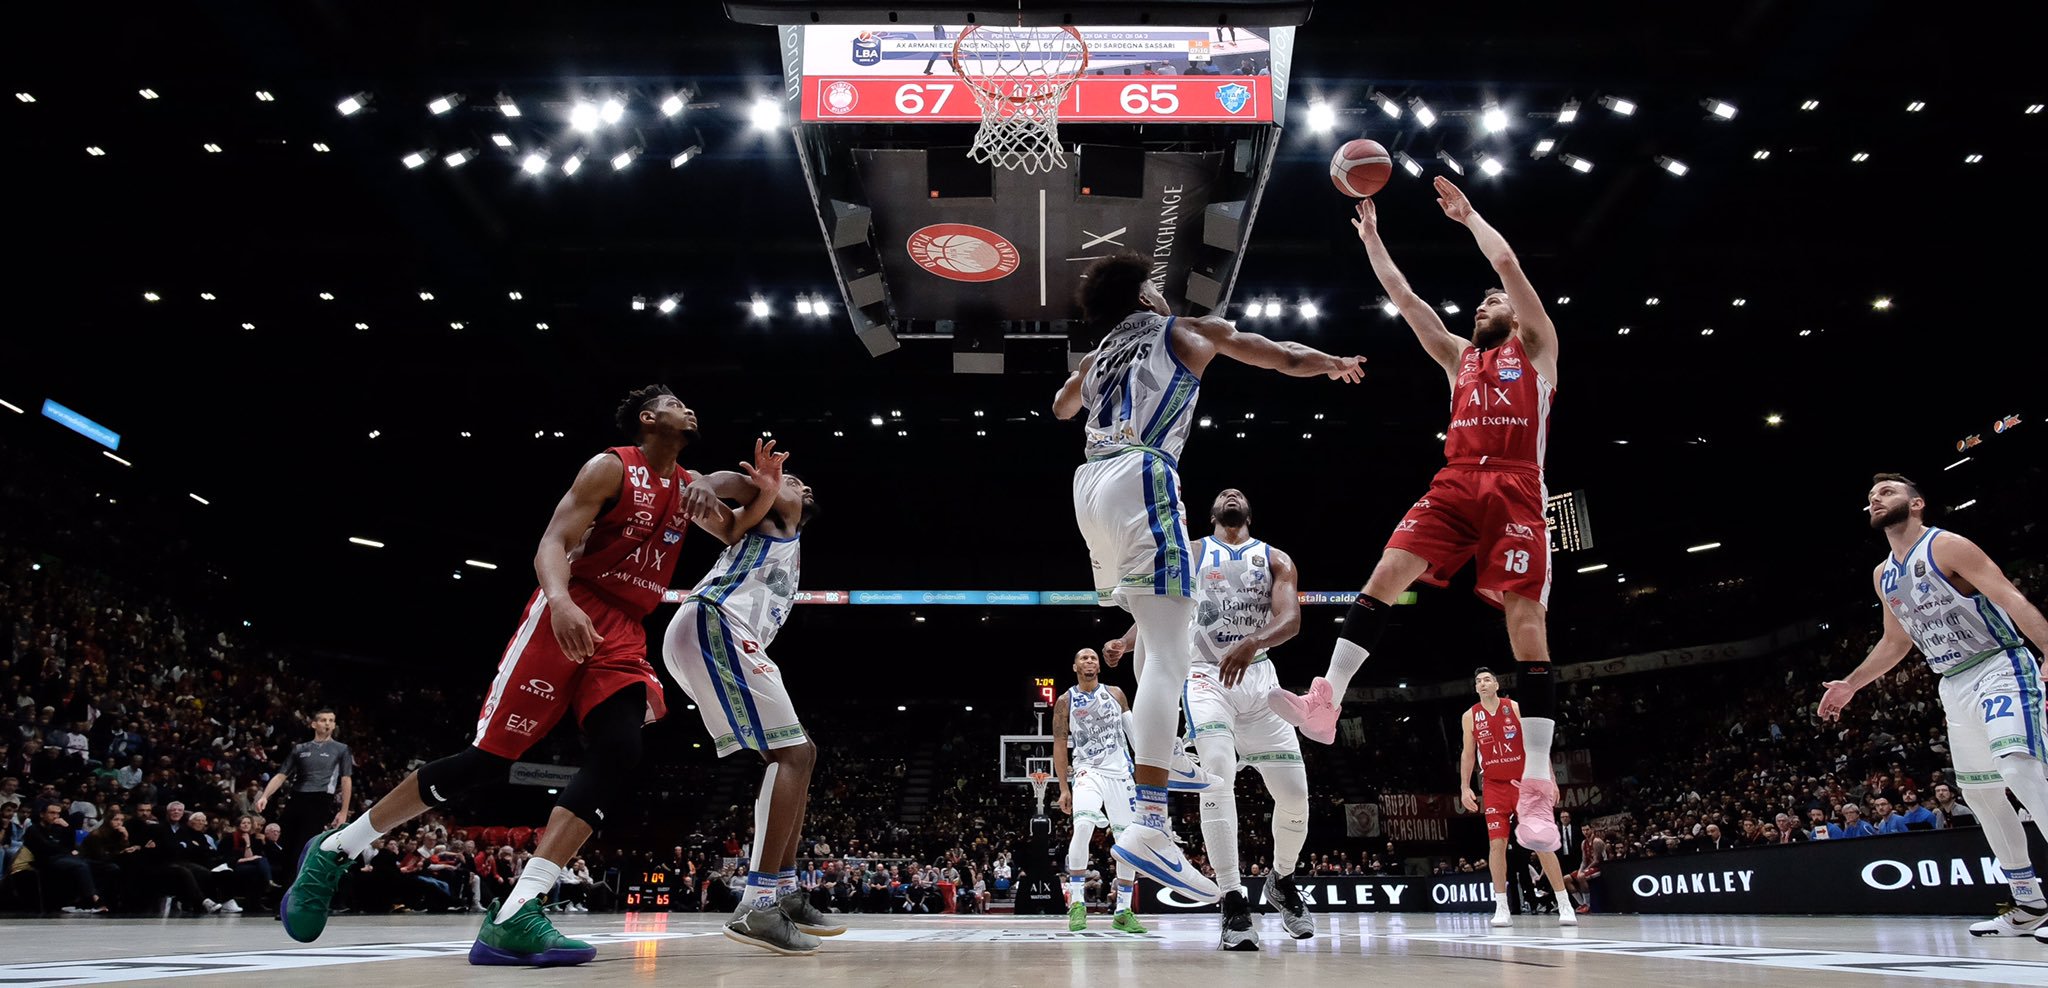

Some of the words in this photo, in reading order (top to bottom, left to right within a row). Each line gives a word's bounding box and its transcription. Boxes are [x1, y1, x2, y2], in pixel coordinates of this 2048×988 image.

[855, 49, 878, 58] LBA
[895, 83, 955, 114] 67
[1119, 83, 1179, 114] 65
[1153, 184, 1184, 259] EXCHANGE
[912, 232, 937, 268] OLIMPIA
[994, 242, 1018, 273] MILANO
[1500, 371, 1520, 381] SAP
[628, 465, 651, 489] 32
[634, 490, 656, 504] EA7
[663, 532, 681, 544] SAP
[1210, 549, 1220, 568] 1
[1504, 549, 1530, 574] 13
[1881, 568, 1898, 594] 22
[1034, 678, 1054, 686] 7:09
[520, 685, 556, 701] OAKLEY
[1042, 687, 1053, 702] 9
[1475, 710, 1486, 722] 40
[1981, 695, 2014, 723] 22
[506, 713, 538, 733] EA7
[1383, 819, 1448, 841] CCASIONALI
[1662, 870, 1753, 894] OAKLEY
[627, 894, 641, 904] 67
[656, 895, 669, 905] 65
